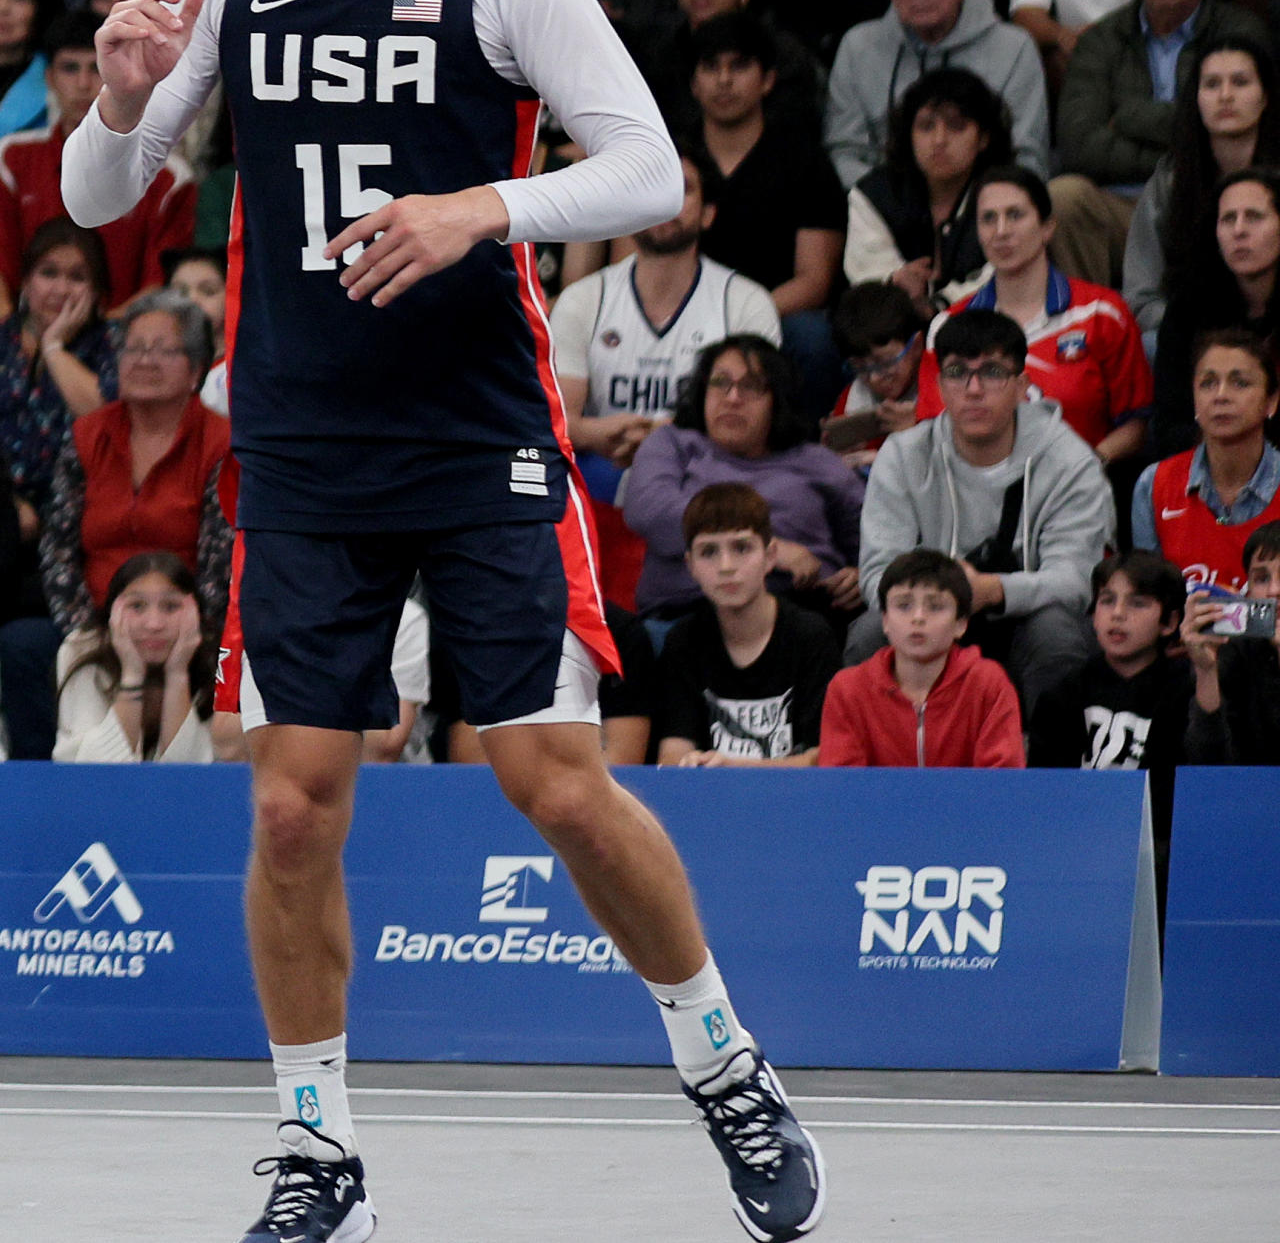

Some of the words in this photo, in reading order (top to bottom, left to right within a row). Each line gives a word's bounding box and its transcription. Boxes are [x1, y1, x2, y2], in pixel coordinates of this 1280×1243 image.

[250, 32, 437, 105] USA
[295, 143, 394, 272] 15
[516, 447, 540, 460] 46
[855, 865, 1007, 910] BOR
[859, 909, 1004, 955] NAN
[16, 953, 146, 978] MINERALS
[858, 956, 909, 970] SPORTS
[912, 956, 999, 970] TECHNOLOGY
